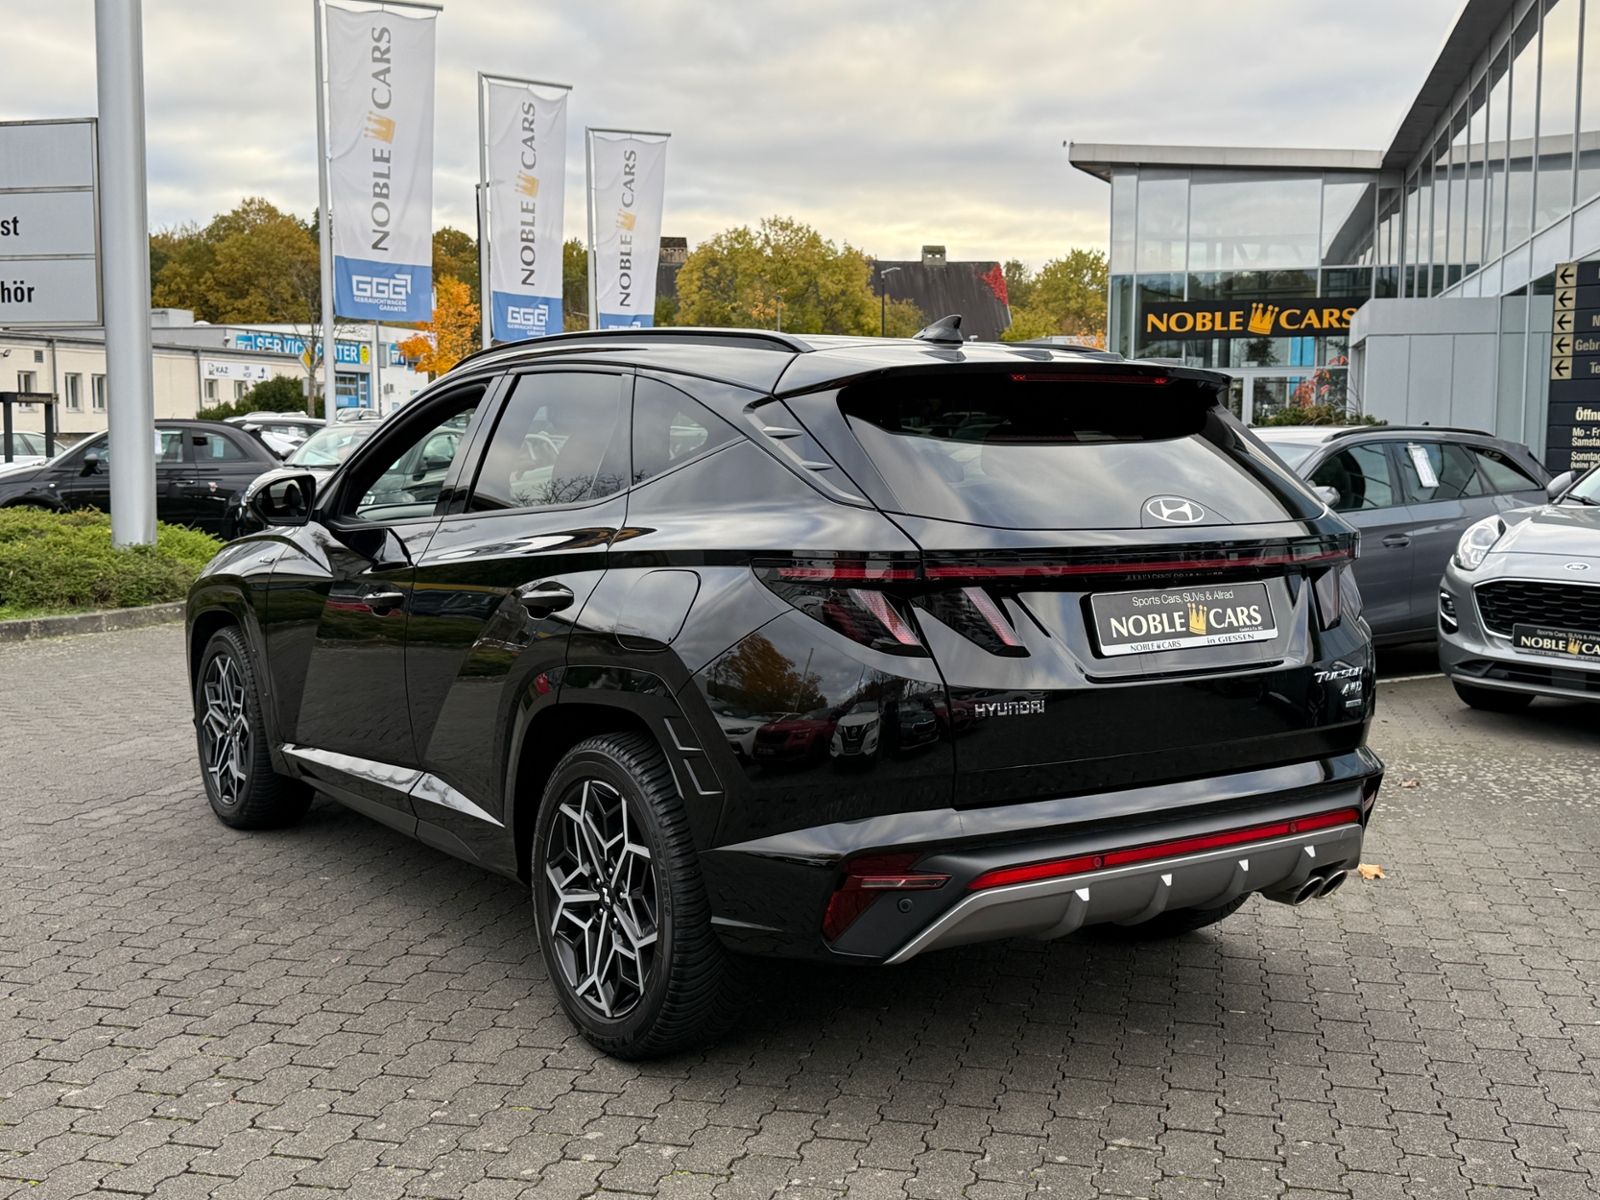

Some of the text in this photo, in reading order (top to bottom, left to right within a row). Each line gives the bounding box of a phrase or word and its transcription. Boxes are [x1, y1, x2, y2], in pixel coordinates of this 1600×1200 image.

[371, 26, 391, 251] NOBLE CARS
[621, 149, 637, 208] CARS
[520, 101, 537, 286] NOBLE CARS
[619, 234, 632, 307] NOBLE
[1147, 308, 1357, 333] NOBLE CARS
[1572, 427, 1585, 437] Mo
[1132, 596, 1160, 607] Sports
[1182, 592, 1205, 602] SUVs
[1206, 591, 1212, 600] &
[1213, 590, 1234, 600] Allrad
[1110, 605, 1263, 638] NOBLE CARS
[1130, 640, 1182, 652] NOBLE CARS
[1218, 633, 1255, 643] GIESSEN
[1521, 635, 1566, 651] NOBLE
[974, 700, 1045, 717] HYUNDAI
